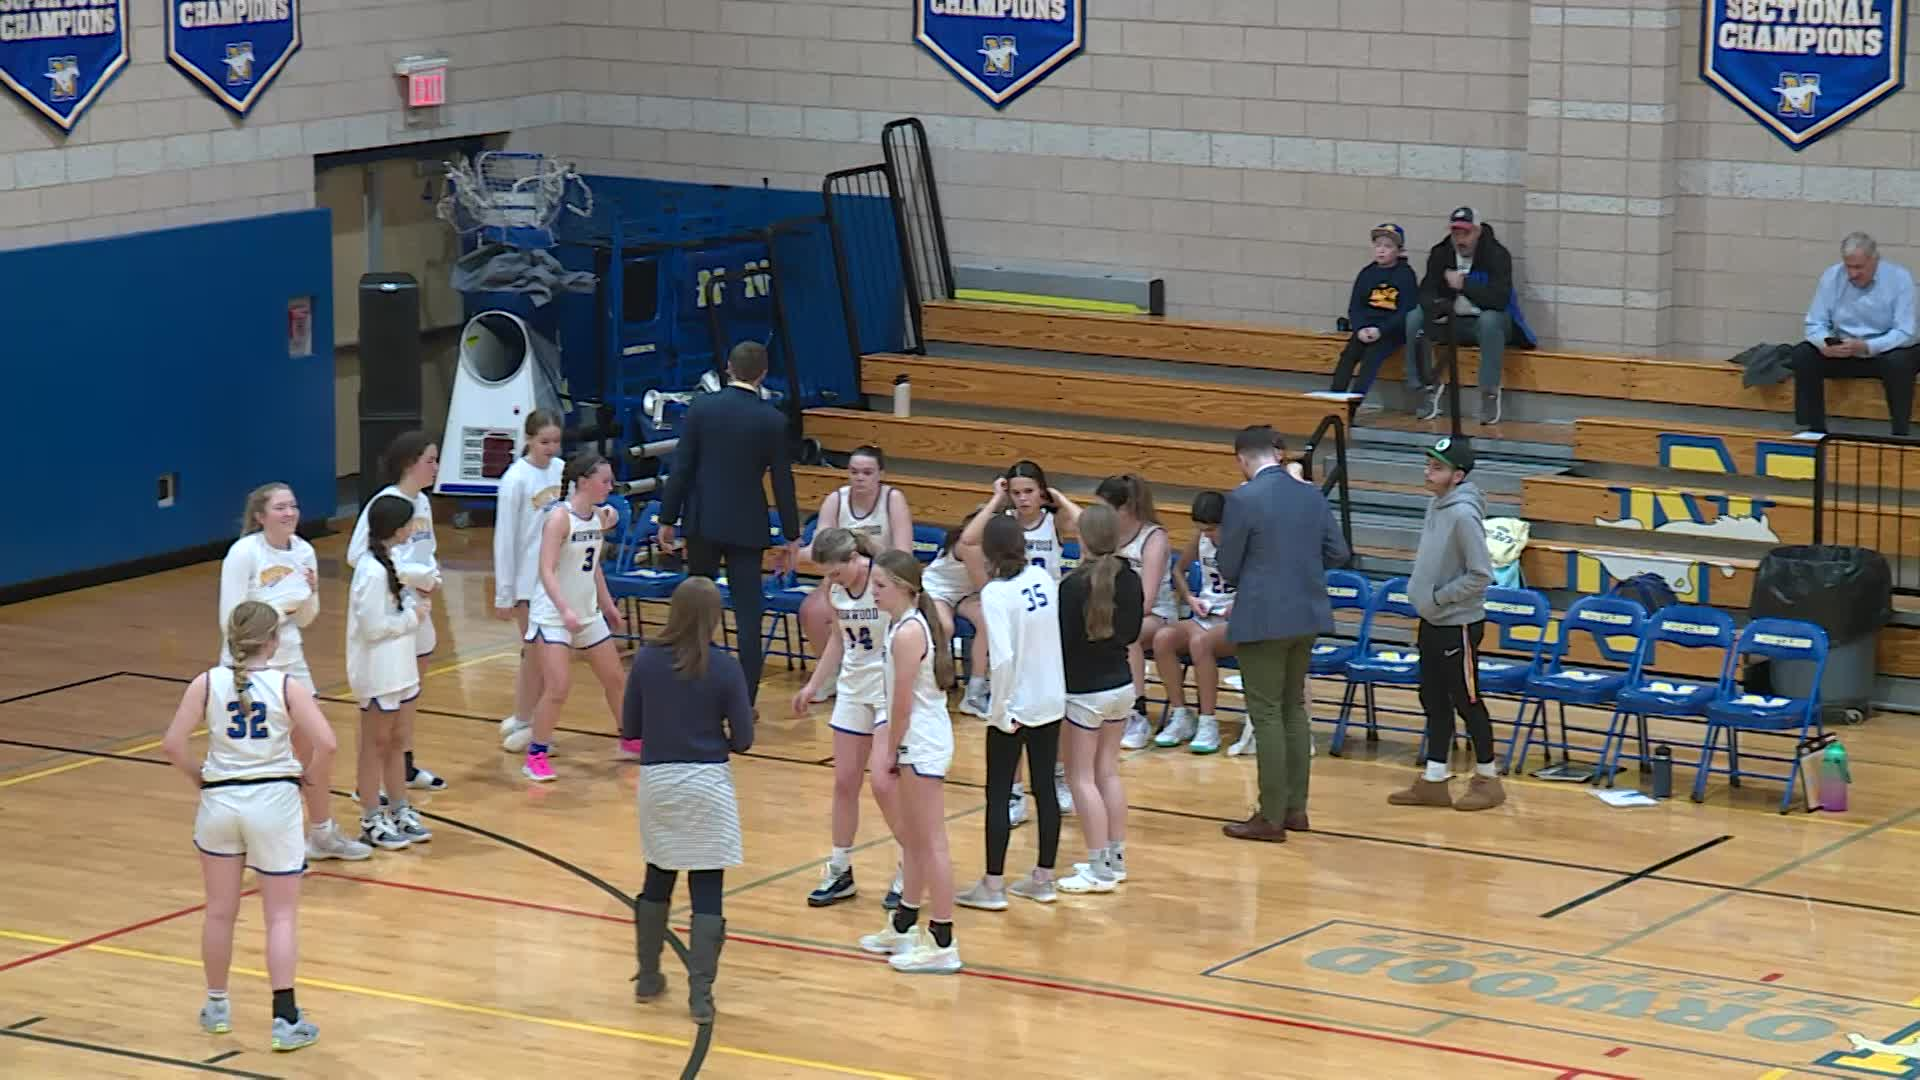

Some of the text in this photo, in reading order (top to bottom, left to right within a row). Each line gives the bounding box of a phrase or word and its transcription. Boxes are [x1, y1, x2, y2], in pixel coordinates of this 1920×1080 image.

[179, 0, 289, 28] CHAMPIONS
[930, 0, 1067, 21] CHAMPIONS
[1726, 0, 1882, 26] SECTIONAL
[0, 9, 116, 41] CHAMPIONS
[1718, 22, 1884, 56] CHAMPIONS
[581, 546, 596, 572] 3
[1020, 582, 1049, 612] 35
[845, 626, 874, 651] 14
[226, 700, 270, 740] 32
